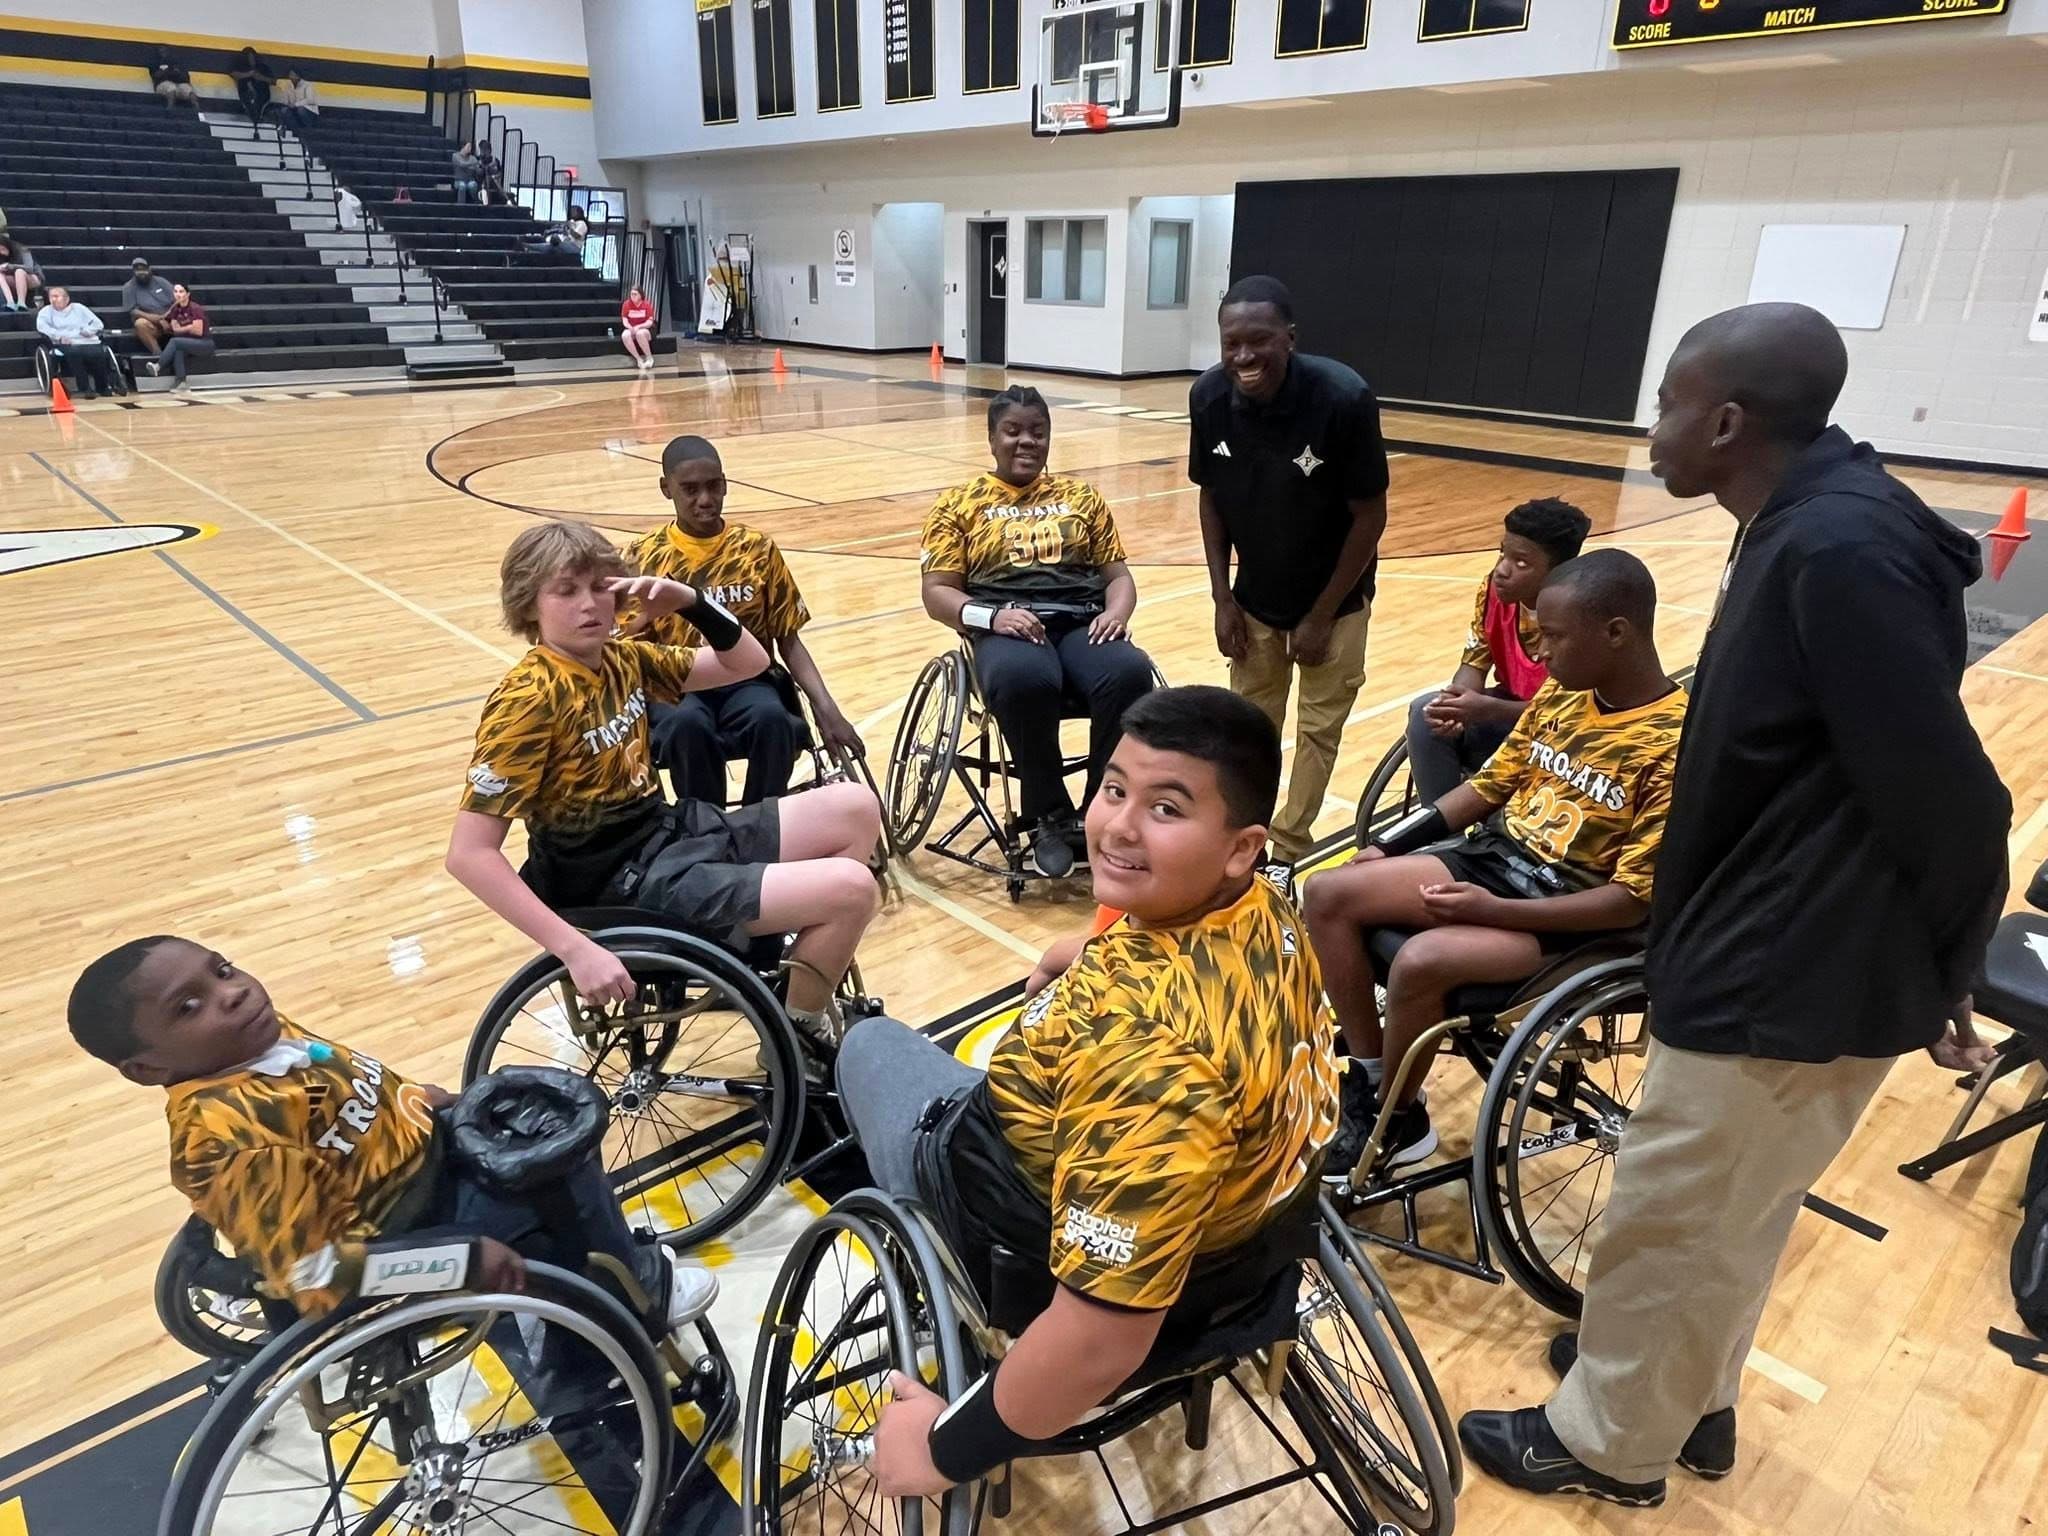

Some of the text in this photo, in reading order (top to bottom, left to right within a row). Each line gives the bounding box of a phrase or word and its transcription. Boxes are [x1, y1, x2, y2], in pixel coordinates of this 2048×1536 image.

[1629, 22, 1672, 41] SCORE
[1763, 7, 1816, 28] MATCH
[984, 502, 1071, 521] TROJANS
[1004, 520, 1064, 568] 30
[1528, 740, 1627, 812] TROJANS
[1064, 1220, 1133, 1264] SPORTS
[1067, 1205, 1139, 1242] adapted
